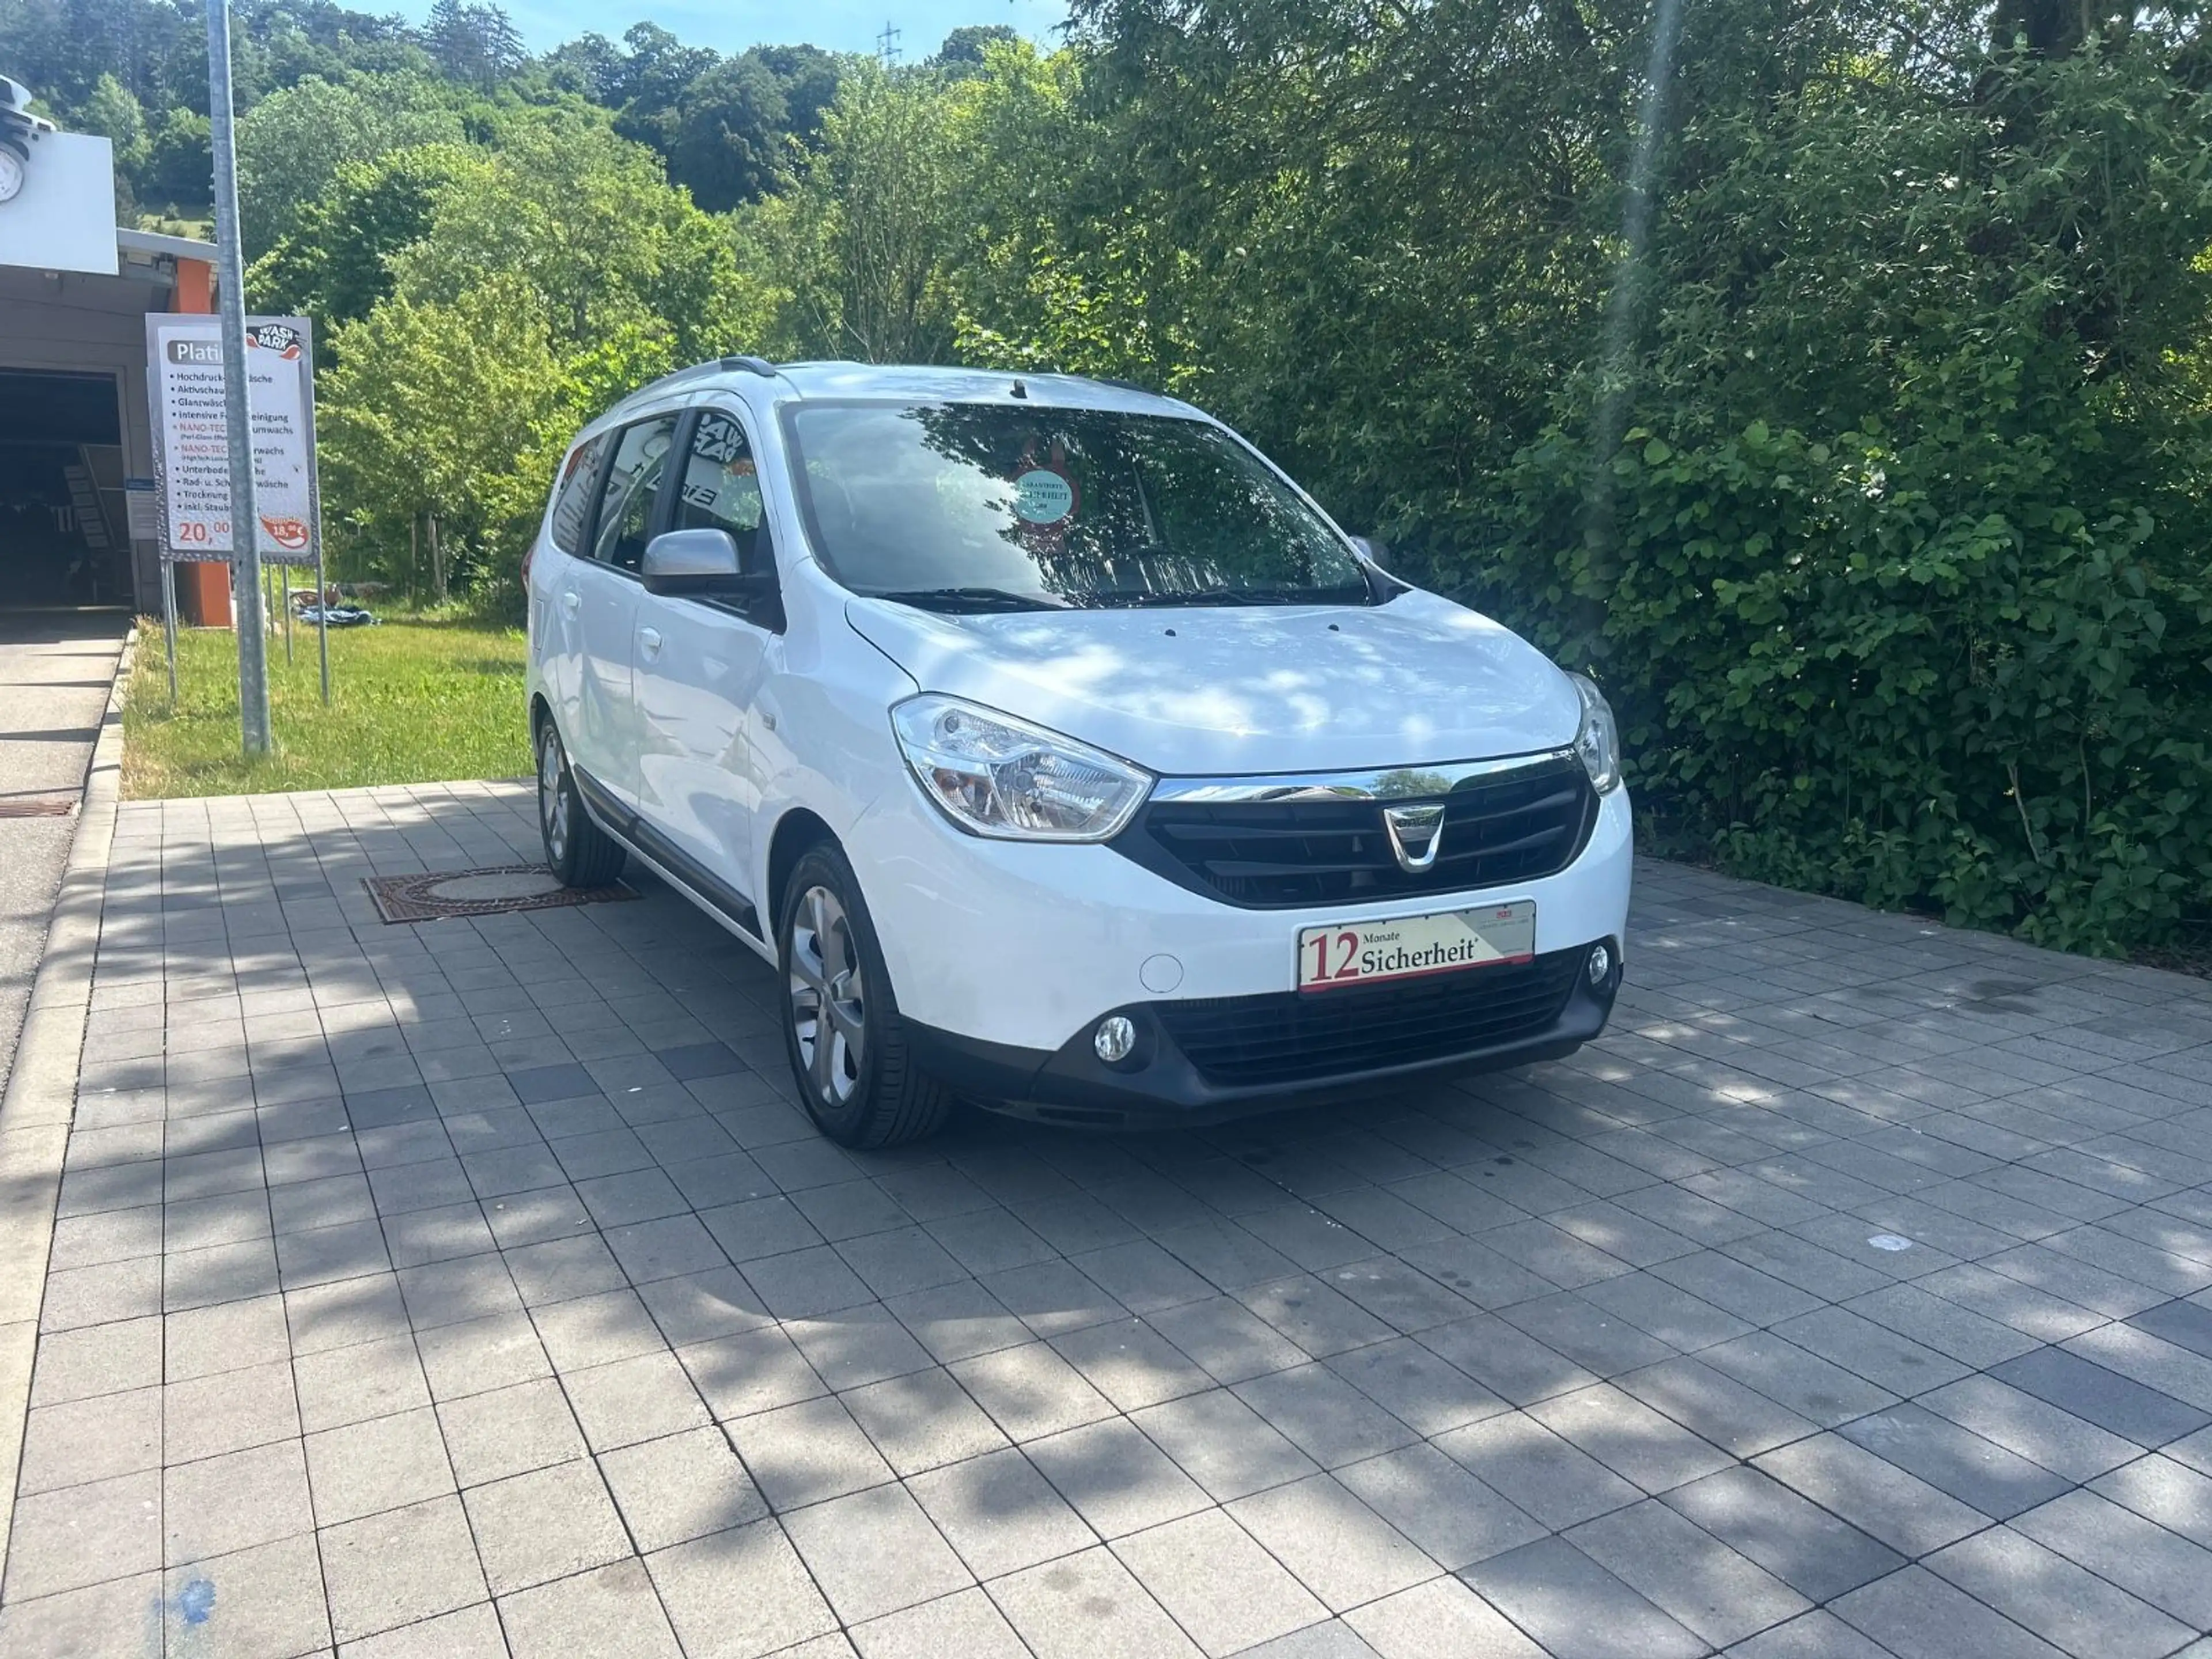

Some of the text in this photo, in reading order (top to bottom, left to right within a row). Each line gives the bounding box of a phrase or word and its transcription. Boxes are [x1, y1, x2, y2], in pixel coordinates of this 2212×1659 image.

[259, 325, 293, 340] WASH
[257, 334, 289, 350] PARK
[177, 342, 224, 361] Plati
[178, 385, 225, 395] Aktivschau
[177, 397, 226, 407] Glanzwäsc
[179, 422, 294, 434] NANO-TEC umwachs
[181, 444, 285, 456] NANO-TEC rwachs
[184, 490, 229, 501] Trocknung
[204, 503, 232, 512] Staub
[1362, 931, 1400, 944] Monate
[1309, 931, 1359, 982] 12
